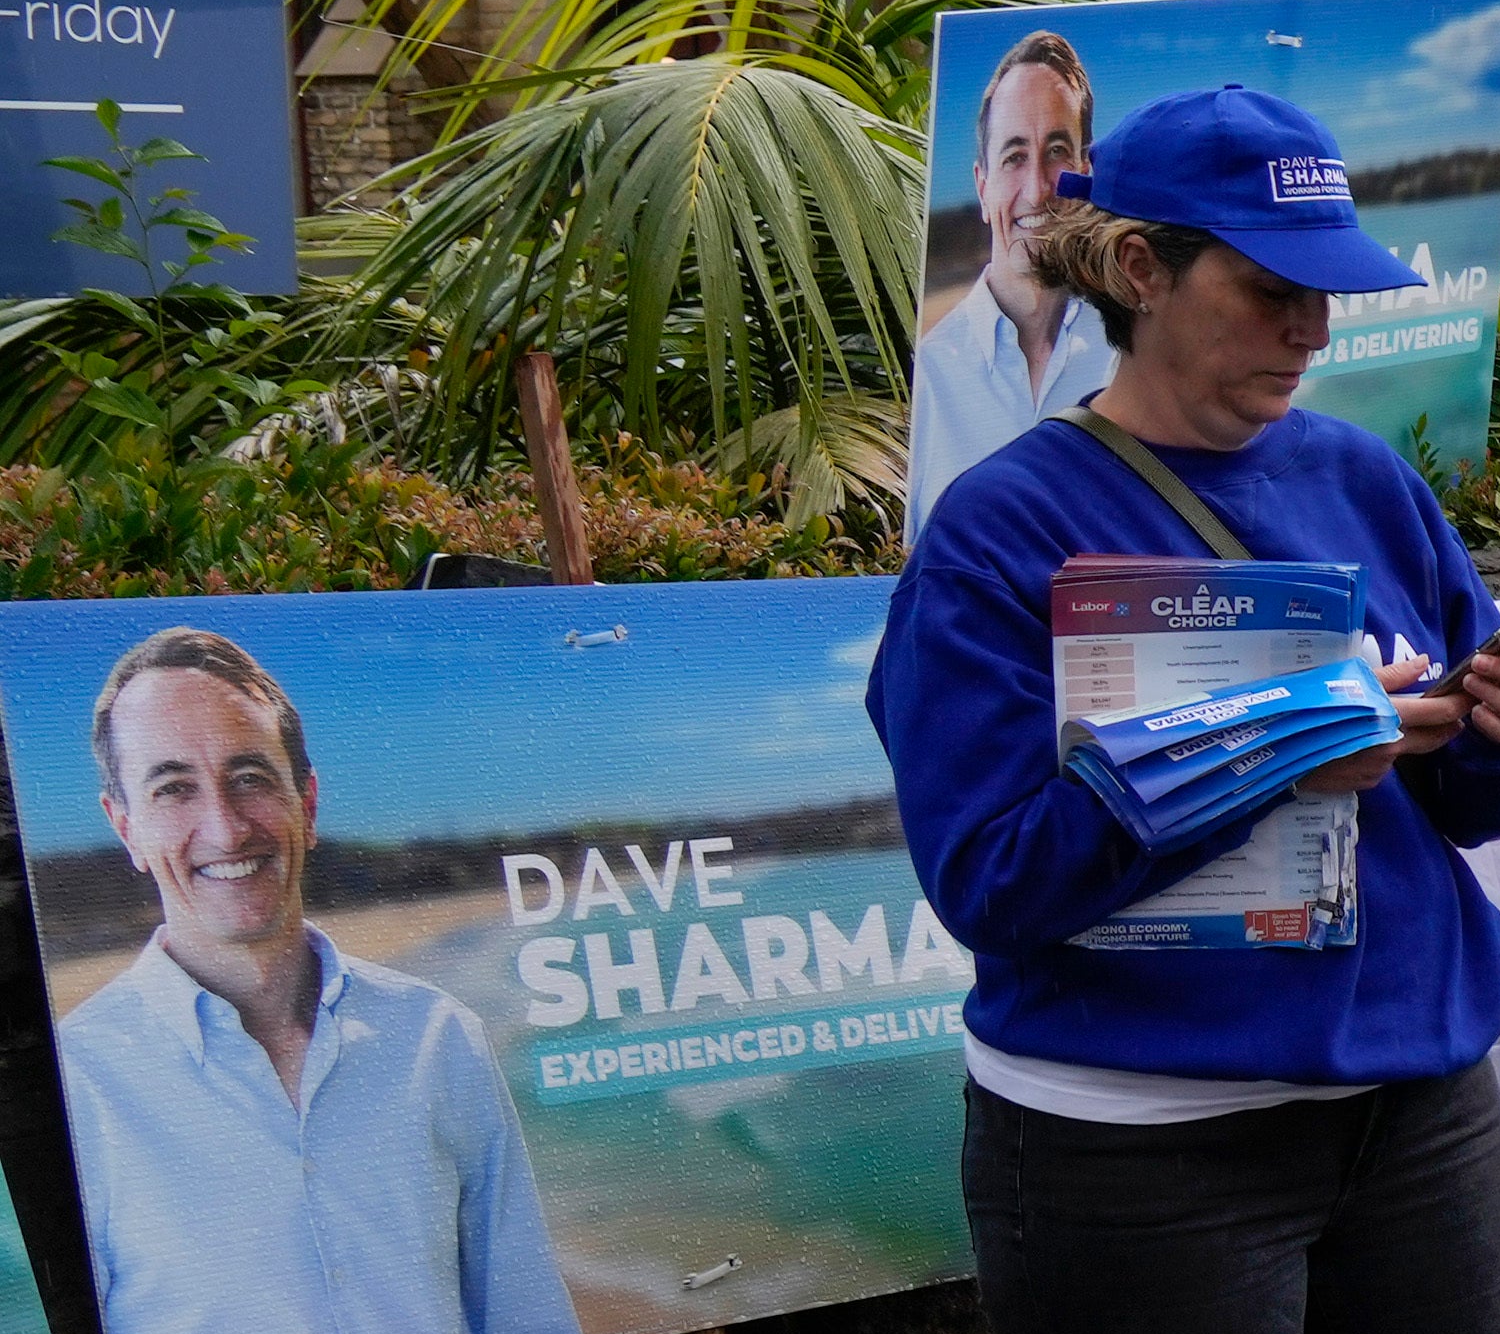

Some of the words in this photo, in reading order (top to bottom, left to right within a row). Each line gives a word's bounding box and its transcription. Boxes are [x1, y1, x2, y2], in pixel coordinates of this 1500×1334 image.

[1280, 156, 1317, 169] DAVE
[1284, 187, 1320, 195] WORKING
[1442, 266, 1486, 304] MP
[1334, 339, 1349, 361] &
[1351, 318, 1478, 360] DELIVERING
[1196, 584, 1210, 595] A
[1072, 602, 1110, 613] Labor
[1150, 596, 1255, 617] CLEAR
[1168, 616, 1237, 628] CHOICE
[501, 837, 744, 925] DAVE
[1130, 923, 1191, 934] ECONOMY.
[1145, 933, 1193, 943] FUTURE.
[519, 900, 972, 1027] SHARMA
[539, 1023, 805, 1090] EXPERIENCED
[812, 1021, 836, 1050] &
